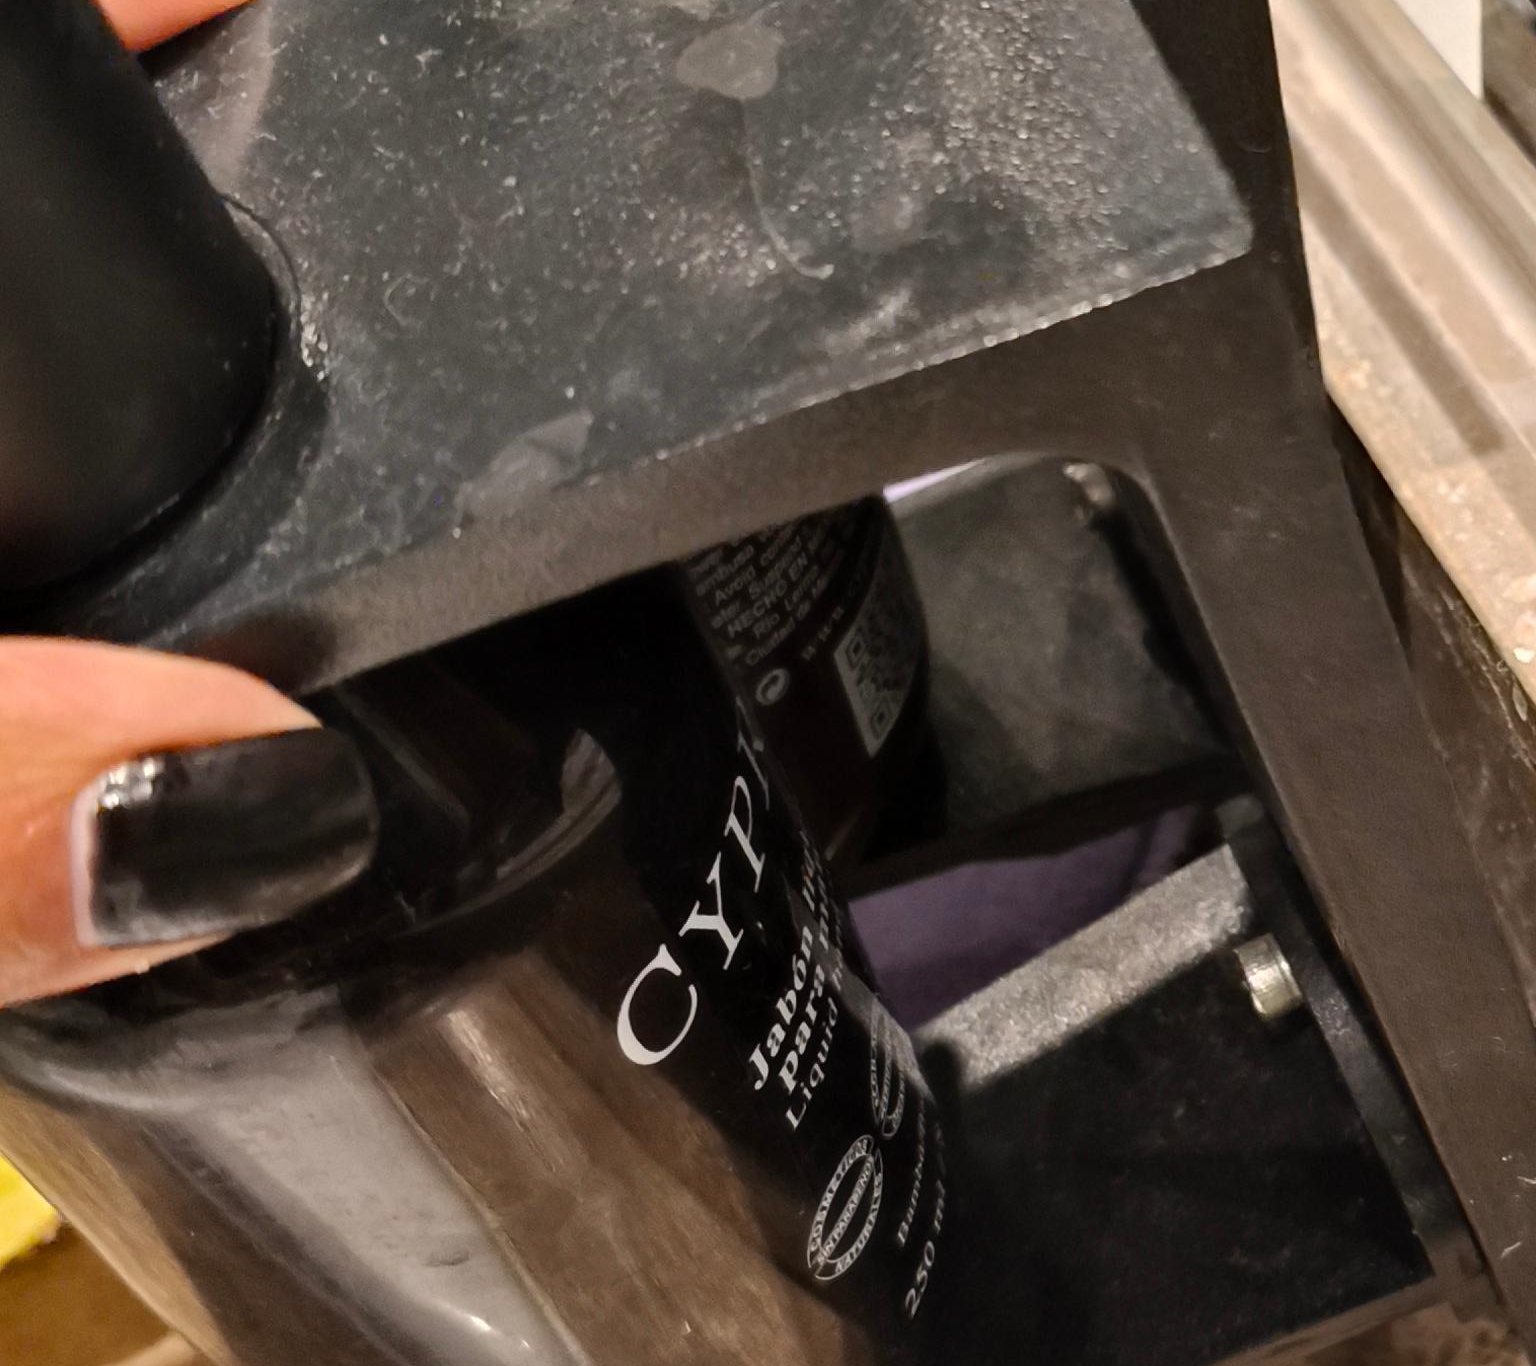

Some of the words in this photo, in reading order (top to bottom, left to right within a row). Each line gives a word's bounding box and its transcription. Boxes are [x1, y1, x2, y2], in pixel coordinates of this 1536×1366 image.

[749, 925, 813, 1090] Jabón
[779, 964, 825, 1094] para
[785, 996, 838, 1131] Liquid
